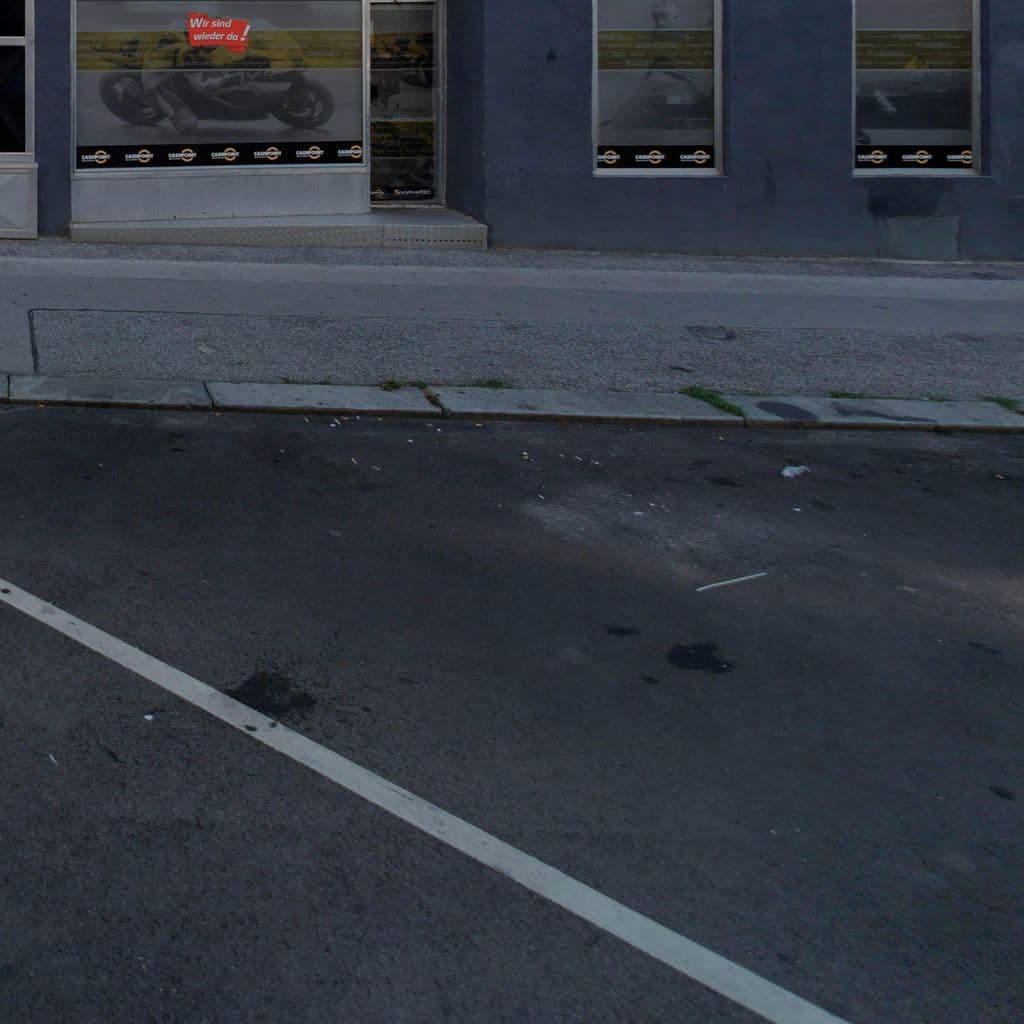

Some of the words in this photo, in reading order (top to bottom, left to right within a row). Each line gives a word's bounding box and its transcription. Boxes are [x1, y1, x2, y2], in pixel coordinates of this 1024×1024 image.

[189, 17, 210, 29] Wir
[211, 18, 232, 28] sind
[193, 30, 225, 41] wieder
